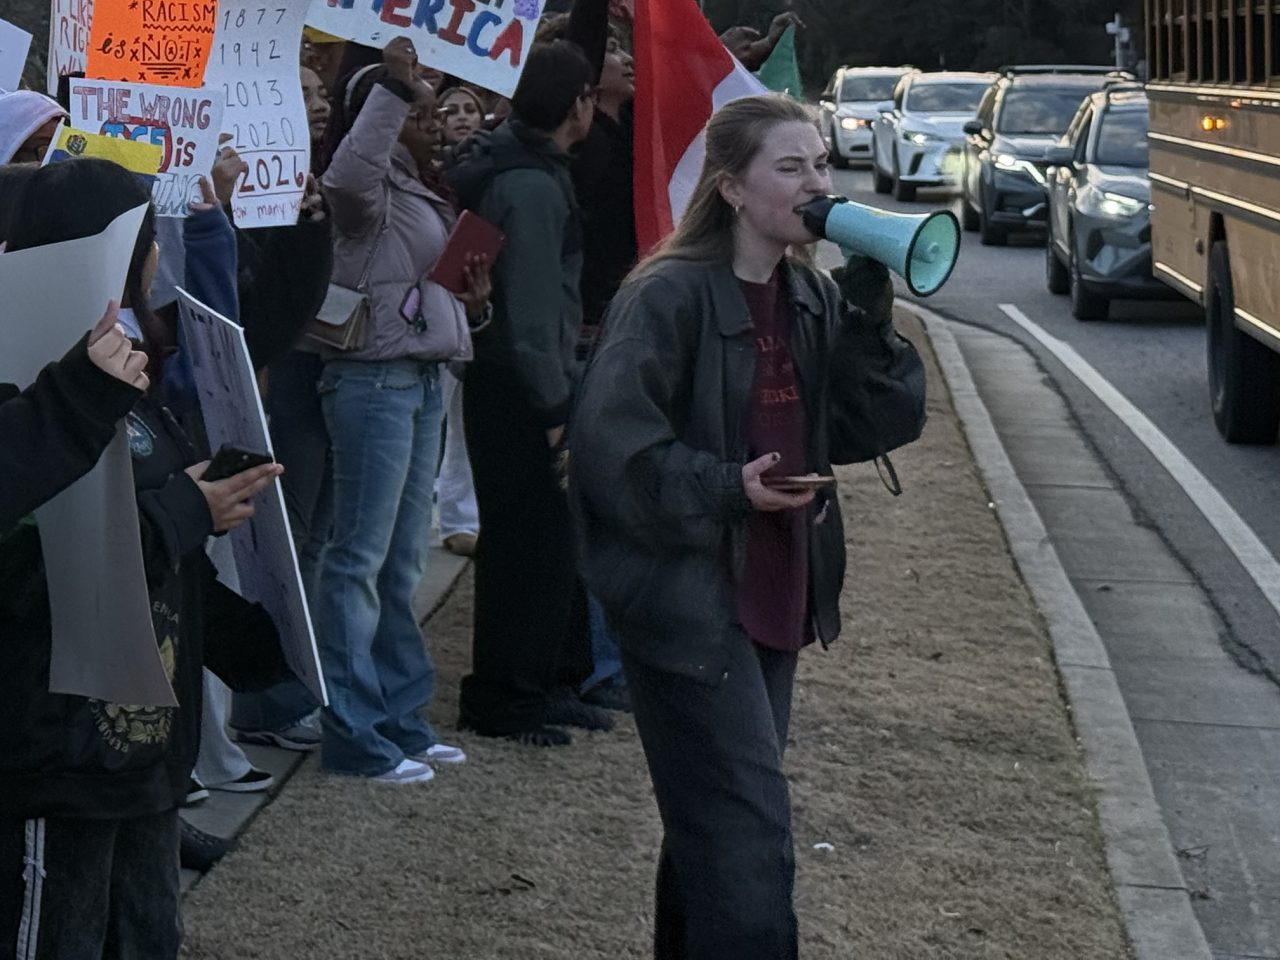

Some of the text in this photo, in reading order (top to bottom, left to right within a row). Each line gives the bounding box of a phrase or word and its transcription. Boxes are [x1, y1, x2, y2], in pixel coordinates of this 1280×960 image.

[142, 0, 216, 23] RACISM
[223, 8, 287, 31] 1877
[60, 16, 88, 56] RIG
[95, 32, 196, 62] is NOT
[220, 39, 281, 68] 1942
[72, 85, 212, 131] THE WRONG
[222, 80, 284, 108] 2013
[232, 117, 295, 150] 2020
[174, 136, 197, 168] is
[238, 154, 305, 193] 2026
[256, 202, 286, 220] many
